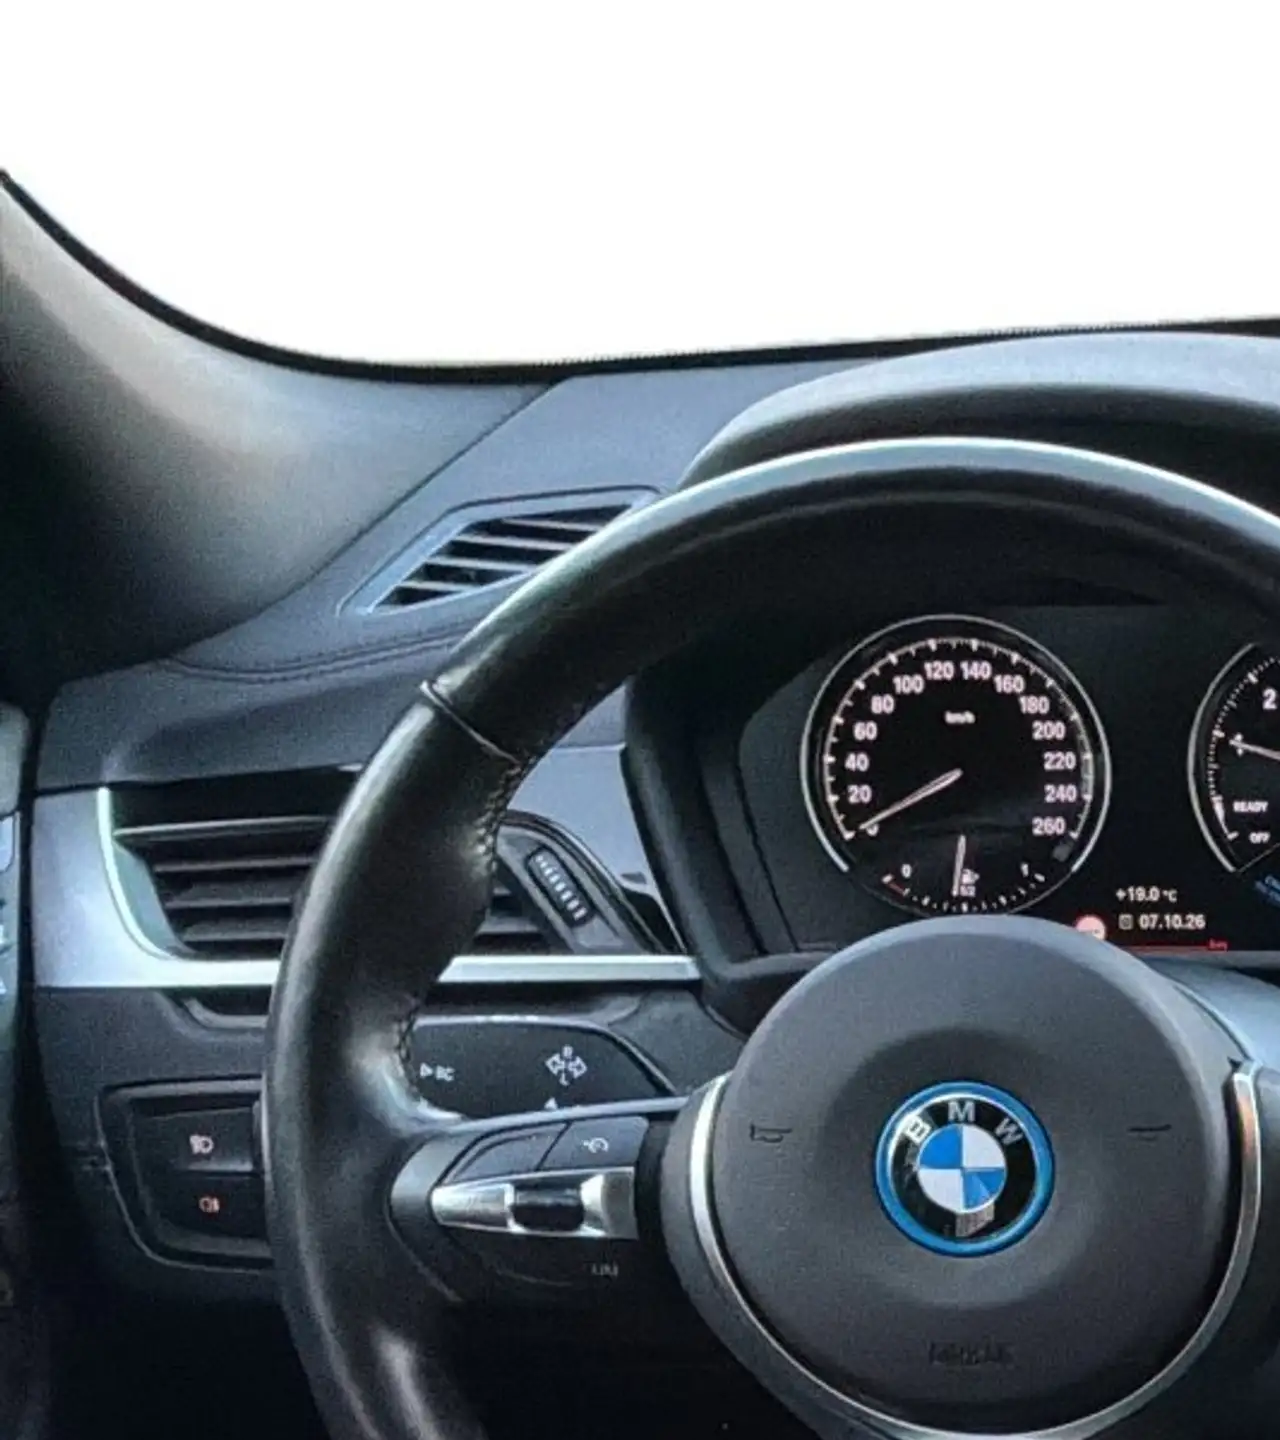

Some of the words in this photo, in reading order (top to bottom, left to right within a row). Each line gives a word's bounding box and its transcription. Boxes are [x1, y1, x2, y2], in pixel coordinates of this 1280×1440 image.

[924, 661, 954, 680] 120
[960, 661, 992, 680] 140
[893, 675, 924, 694] 100
[994, 675, 1025, 693] 160
[871, 695, 894, 713] 80
[1019, 696, 1050, 714] 180
[1262, 689, 1277, 710] 2
[853, 722, 877, 740] 60
[1032, 722, 1066, 740] 200
[845, 754, 869, 771] 40
[1044, 752, 1076, 770] 220
[849, 785, 872, 802] 20
[1045, 785, 1077, 802] 240
[1233, 801, 1268, 812] READY
[1032, 817, 1065, 835] 260
[1250, 832, 1270, 843] OFF
[1139, 914, 1206, 929] 07.10.26
[904, 1101, 1024, 1145] BMW
